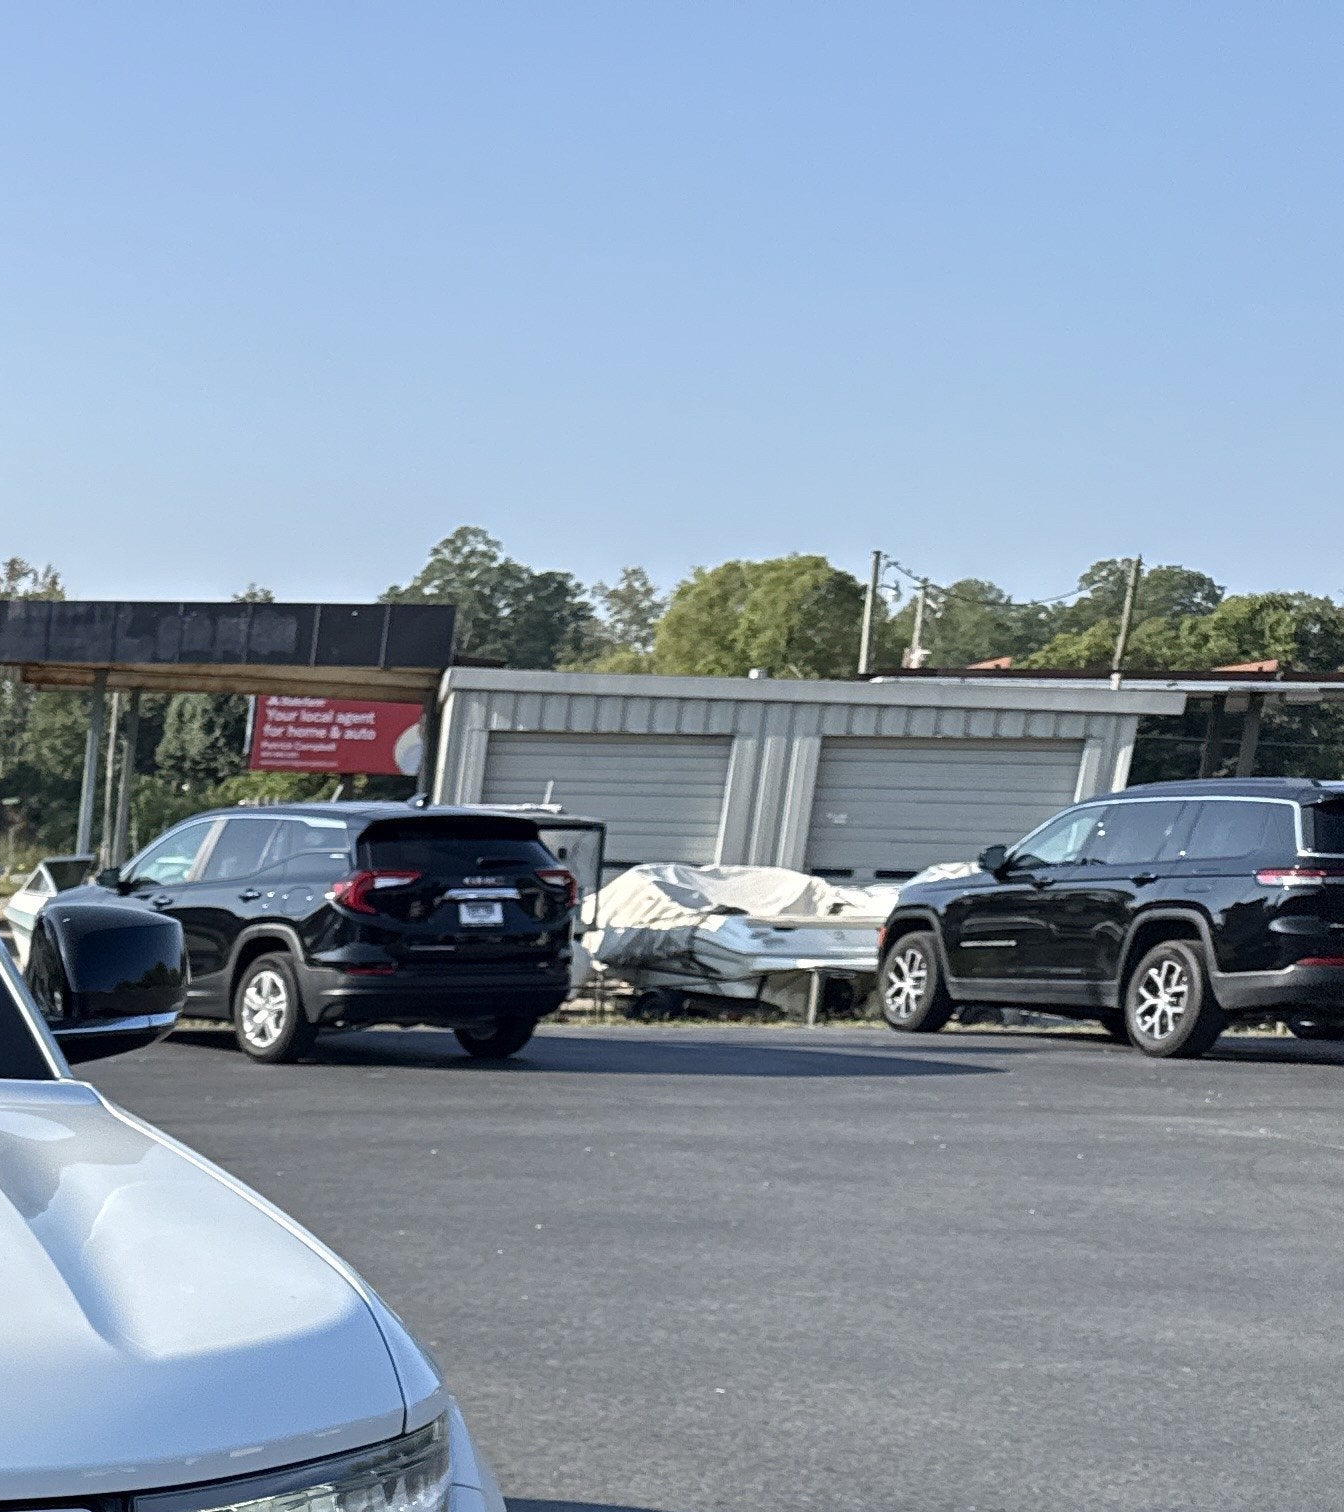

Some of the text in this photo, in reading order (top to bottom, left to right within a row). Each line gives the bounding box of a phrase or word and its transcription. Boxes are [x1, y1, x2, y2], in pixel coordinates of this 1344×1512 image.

[266, 708, 375, 726] Your local agent
[263, 724, 376, 740] for home & auto
